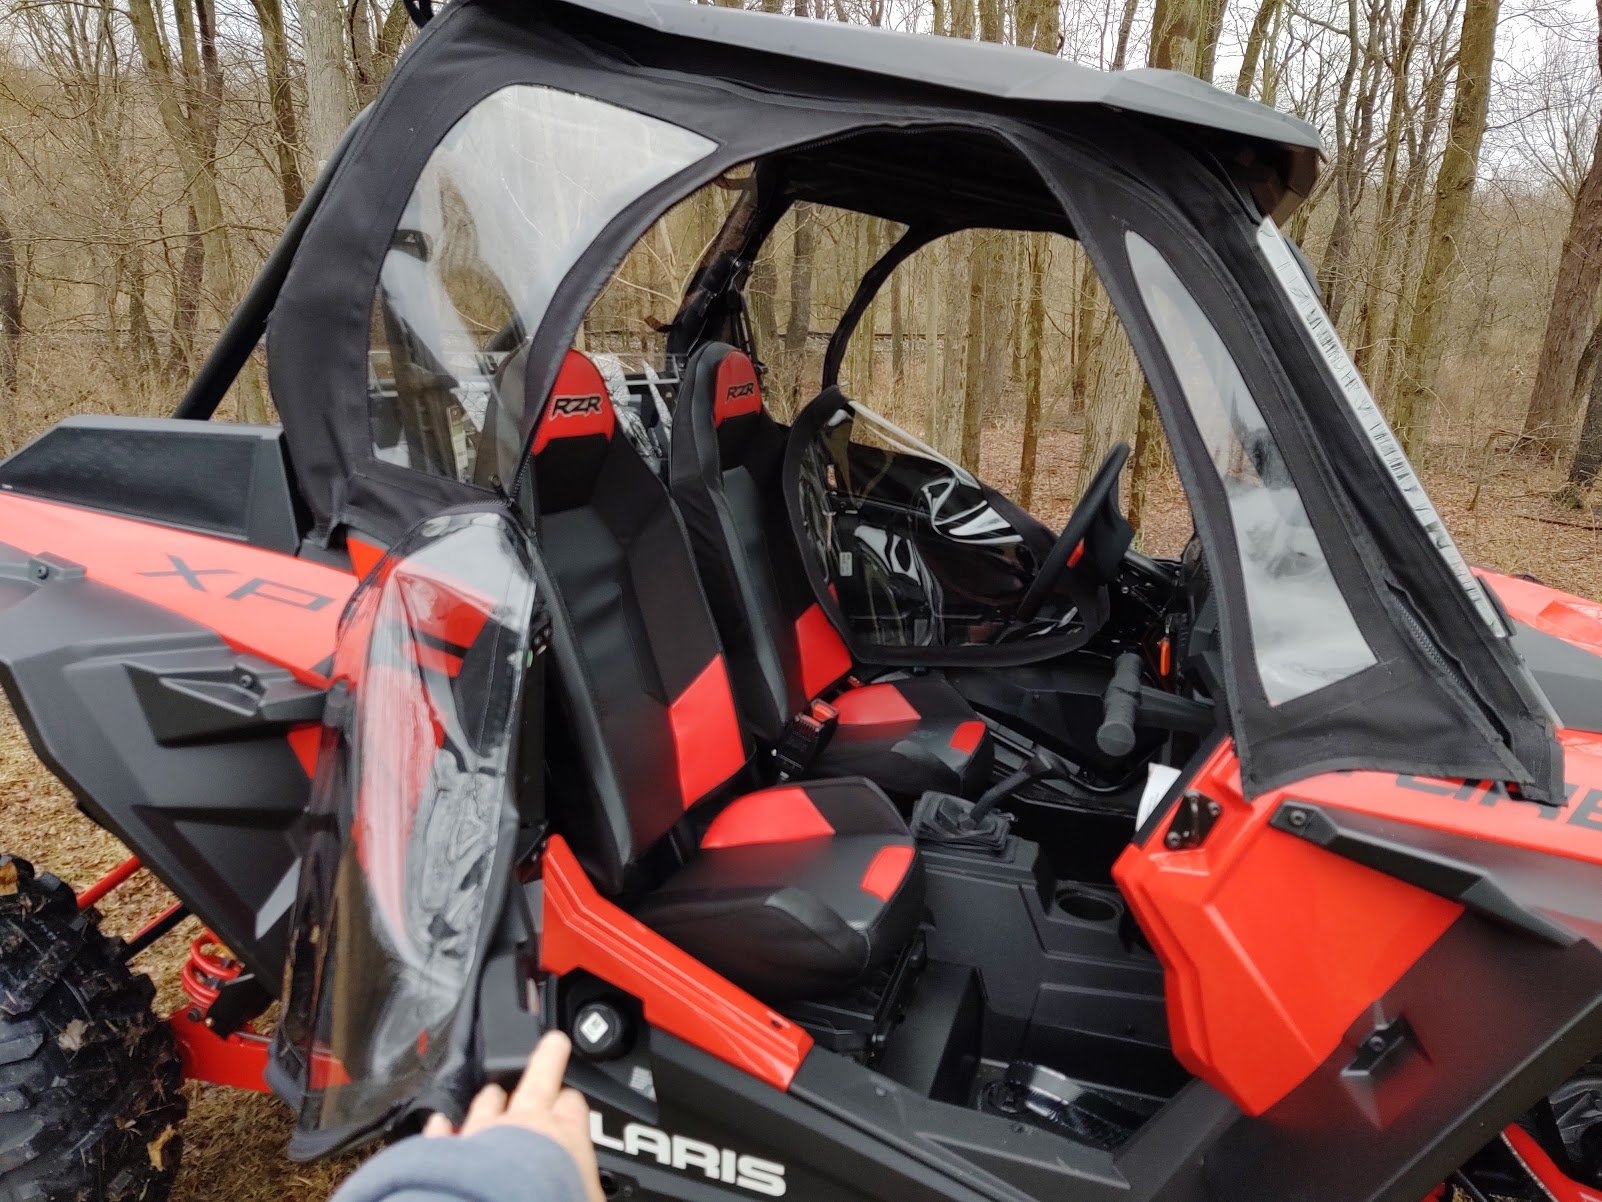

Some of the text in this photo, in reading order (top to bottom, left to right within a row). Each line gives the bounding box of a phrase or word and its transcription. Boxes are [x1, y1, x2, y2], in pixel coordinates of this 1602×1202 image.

[551, 395, 601, 420] RZR
[725, 382, 755, 402] RZR
[135, 554, 335, 611] XP
[588, 1110, 787, 1197] LARIS
